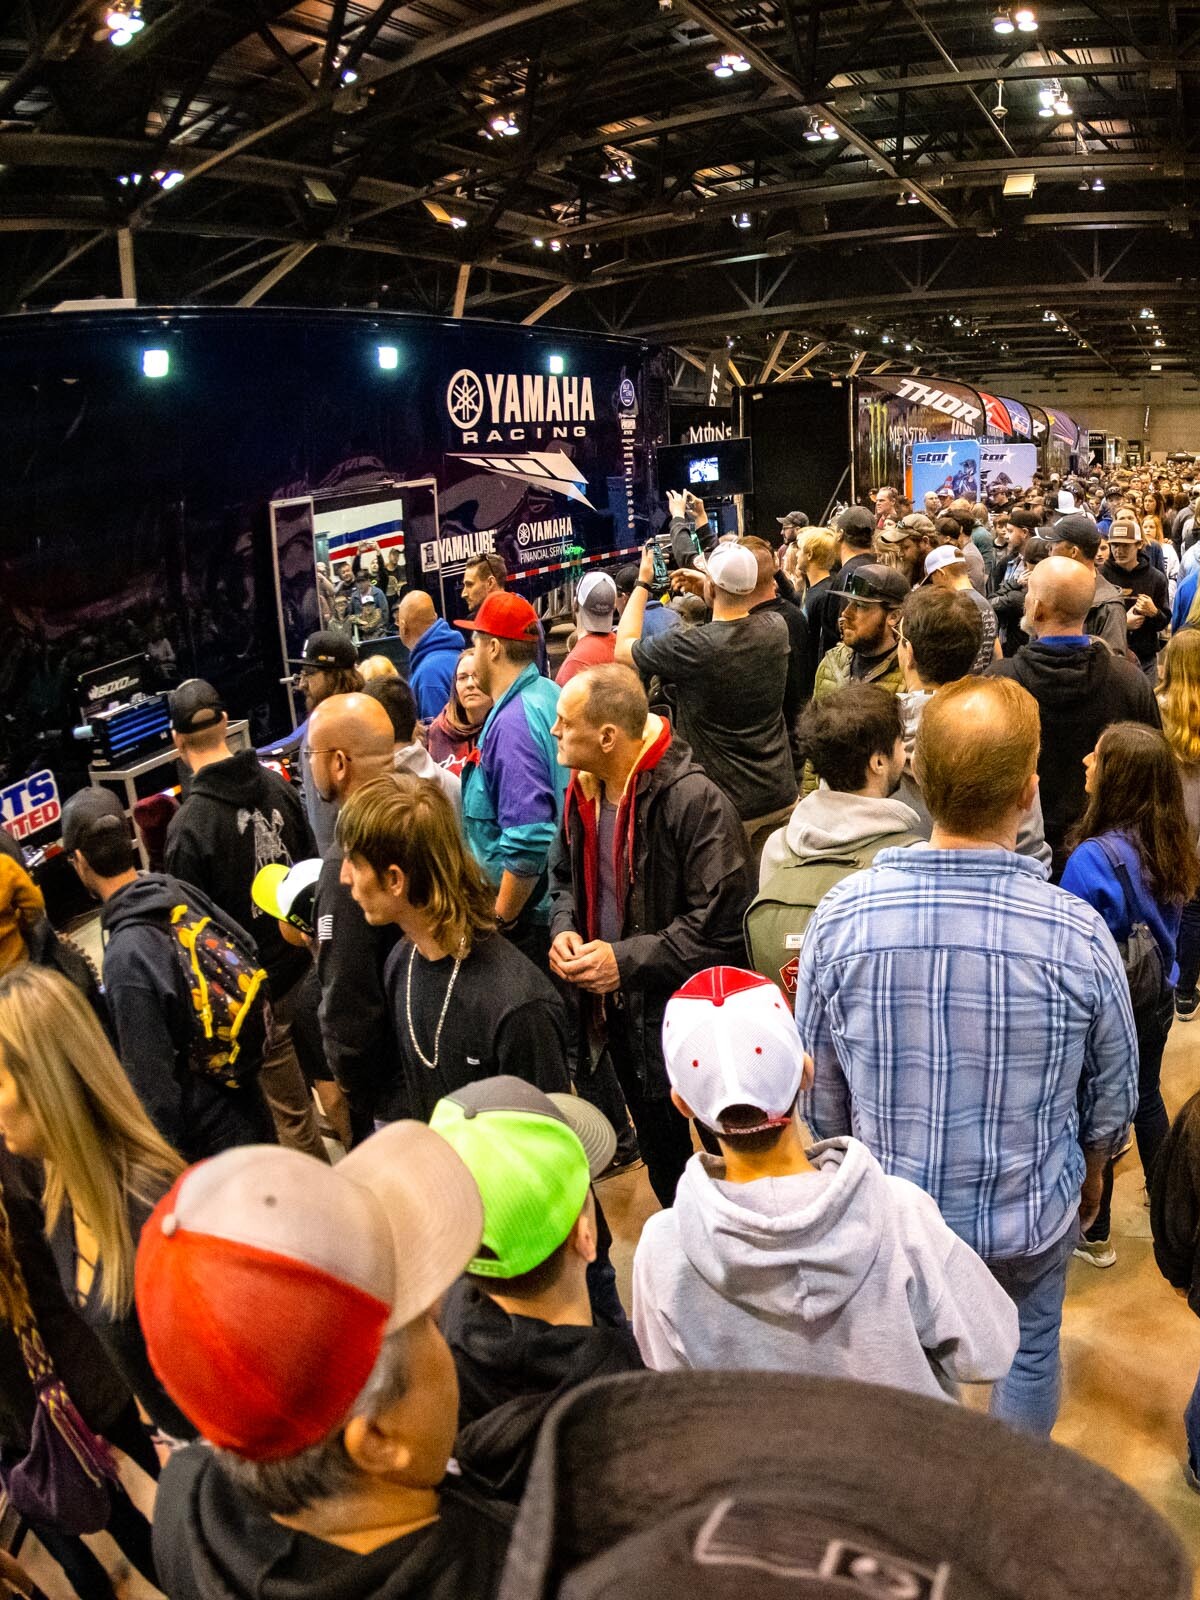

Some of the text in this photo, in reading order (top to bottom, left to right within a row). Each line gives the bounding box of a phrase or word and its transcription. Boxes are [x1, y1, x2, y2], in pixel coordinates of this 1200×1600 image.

[485, 373, 595, 424] YAMAHA
[896, 379, 982, 424] THOR
[462, 426, 586, 445] RACING
[530, 516, 573, 542] YAMAHA
[439, 529, 497, 563] YAMALUBE
[520, 549, 550, 564] FINANCIAL
